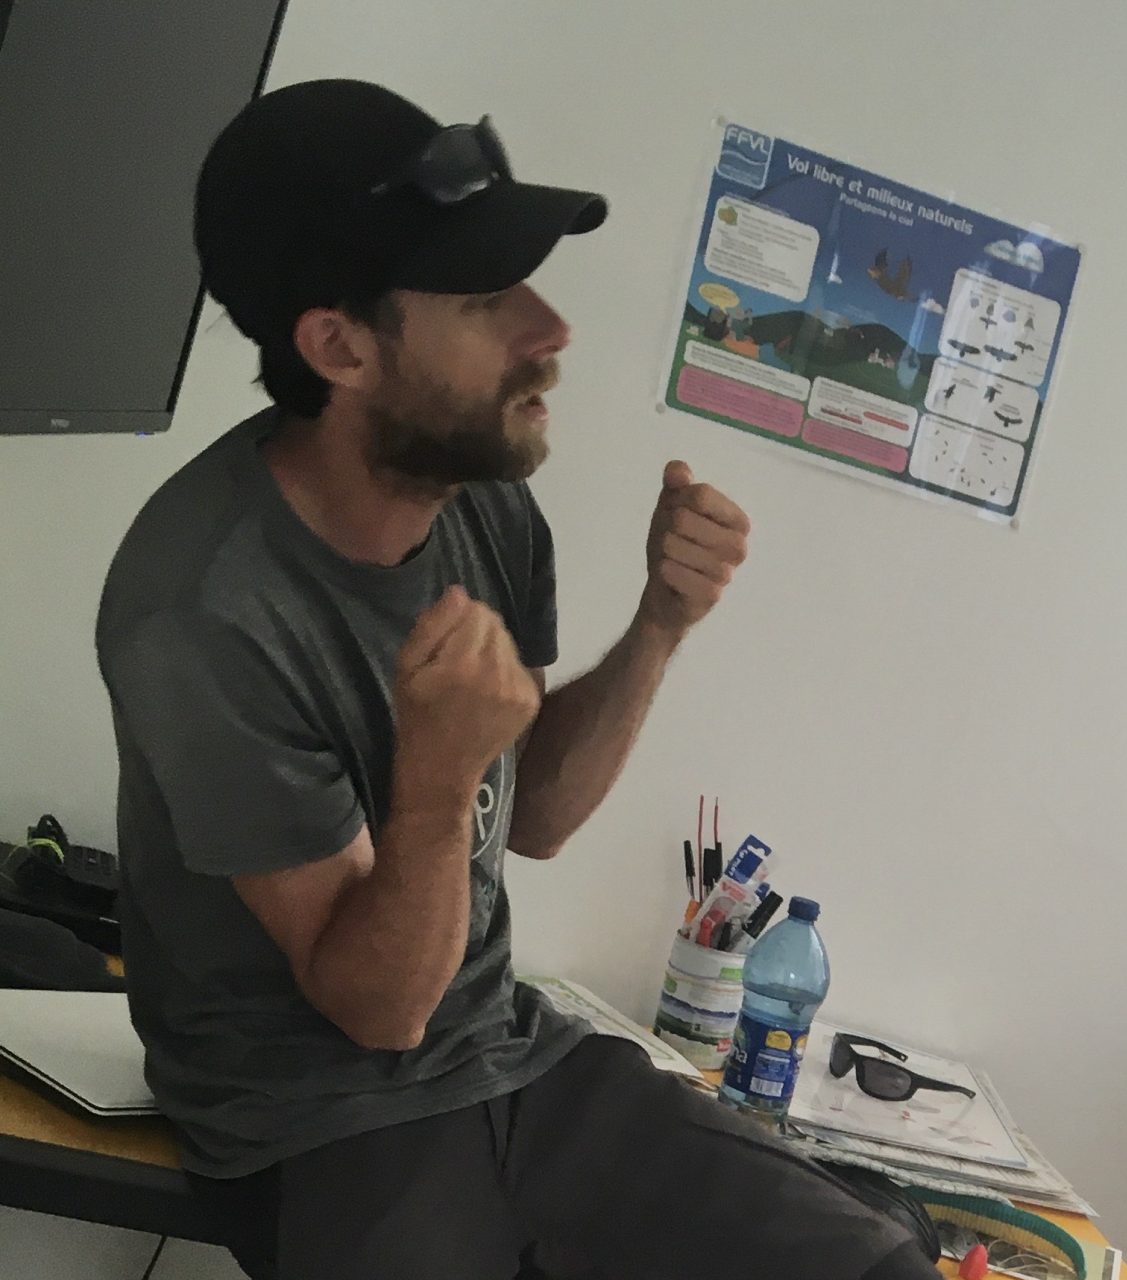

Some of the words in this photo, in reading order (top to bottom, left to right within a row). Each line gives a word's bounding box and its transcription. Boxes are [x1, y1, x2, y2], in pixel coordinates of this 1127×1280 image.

[726, 127, 769, 156] FFVL
[787, 152, 810, 175] Vol
[812, 163, 845, 189] libre
[848, 179, 863, 195] et
[866, 187, 914, 213] milieux
[917, 205, 974, 236] naturels
